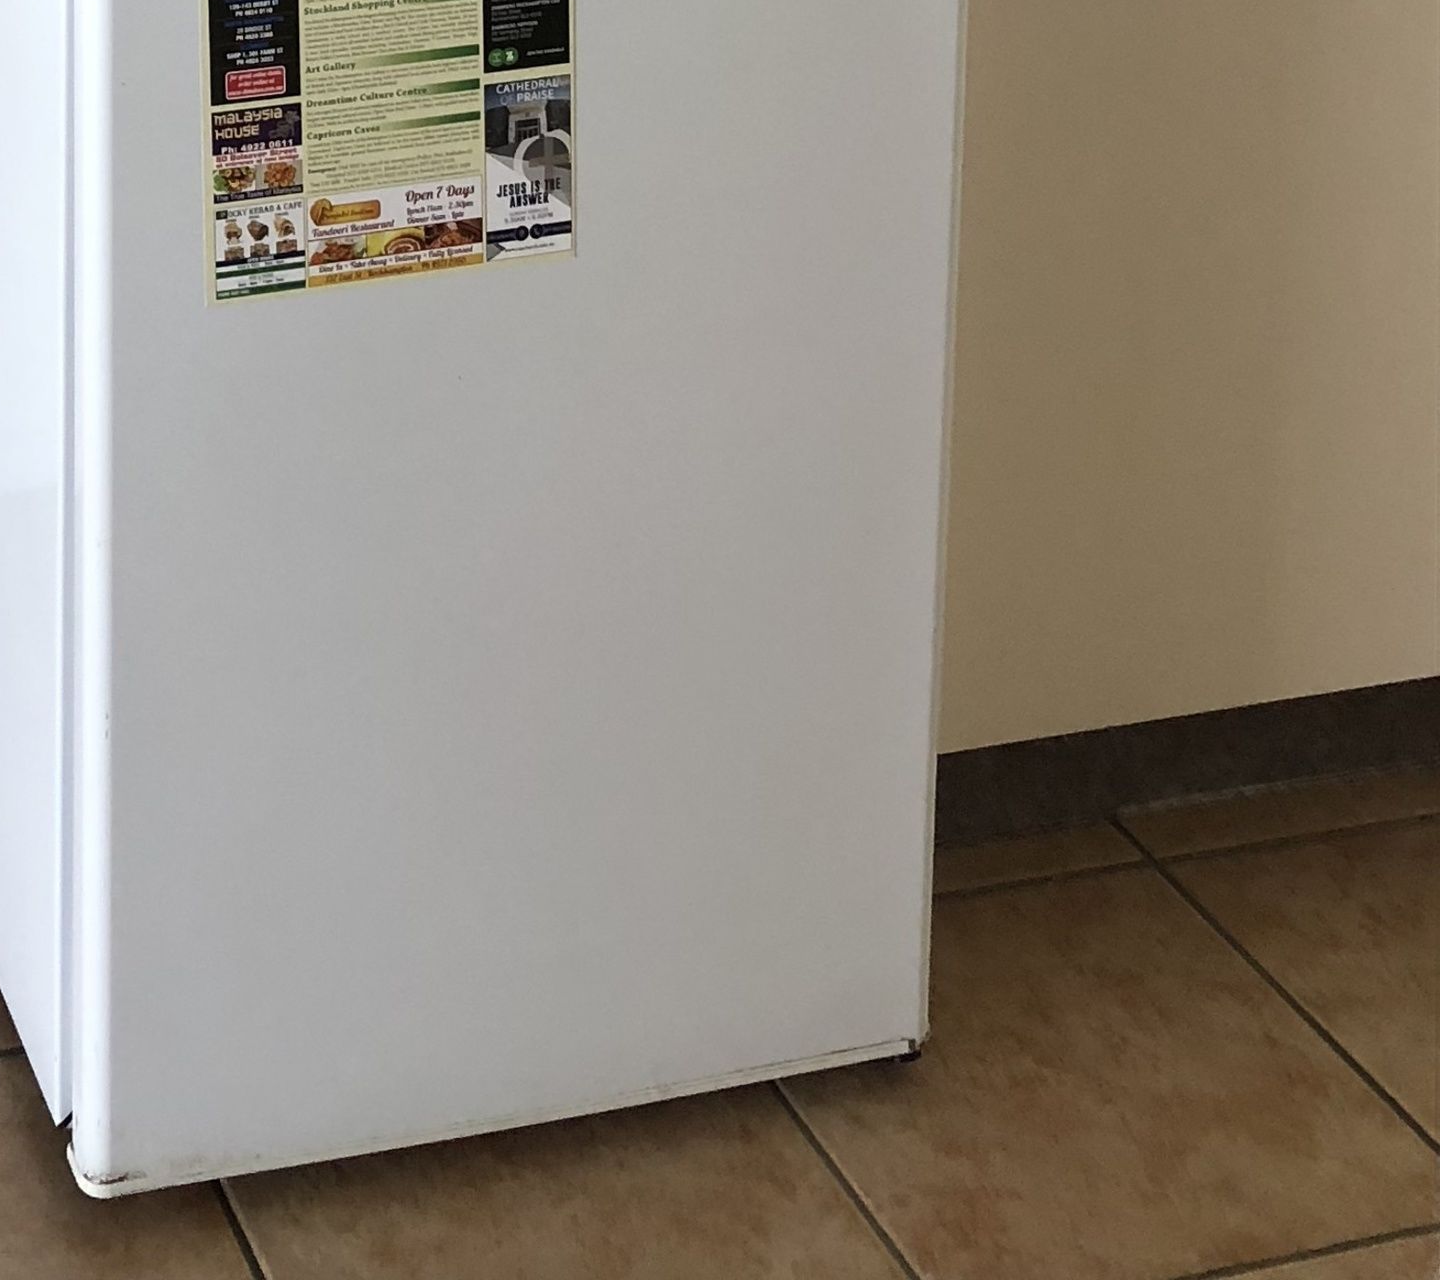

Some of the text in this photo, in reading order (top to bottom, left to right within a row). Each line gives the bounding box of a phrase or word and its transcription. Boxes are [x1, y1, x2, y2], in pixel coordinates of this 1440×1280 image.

[304, 3, 350, 15] Stockland
[306, 62, 356, 74] Art Gallery
[496, 79, 558, 94] CATHEDRAL
[306, 87, 427, 108] Dreamtime Culture Centre
[500, 90, 555, 105] OF PRAISE
[215, 124, 259, 140] HOUSE
[307, 126, 380, 140] Capricorn Caves
[221, 139, 293, 155] Ph: 4922 0611
[405, 184, 474, 204] Open 7 Days
[497, 177, 561, 198] JESUS IS THE
[249, 204, 274, 214] KEBAB
[283, 201, 302, 210] CAFE
[510, 192, 549, 208] ANSWER
[312, 219, 395, 237] Tandoori Restaurant
[394, 253, 421, 263] Delivery
[428, 250, 445, 258] Fully
